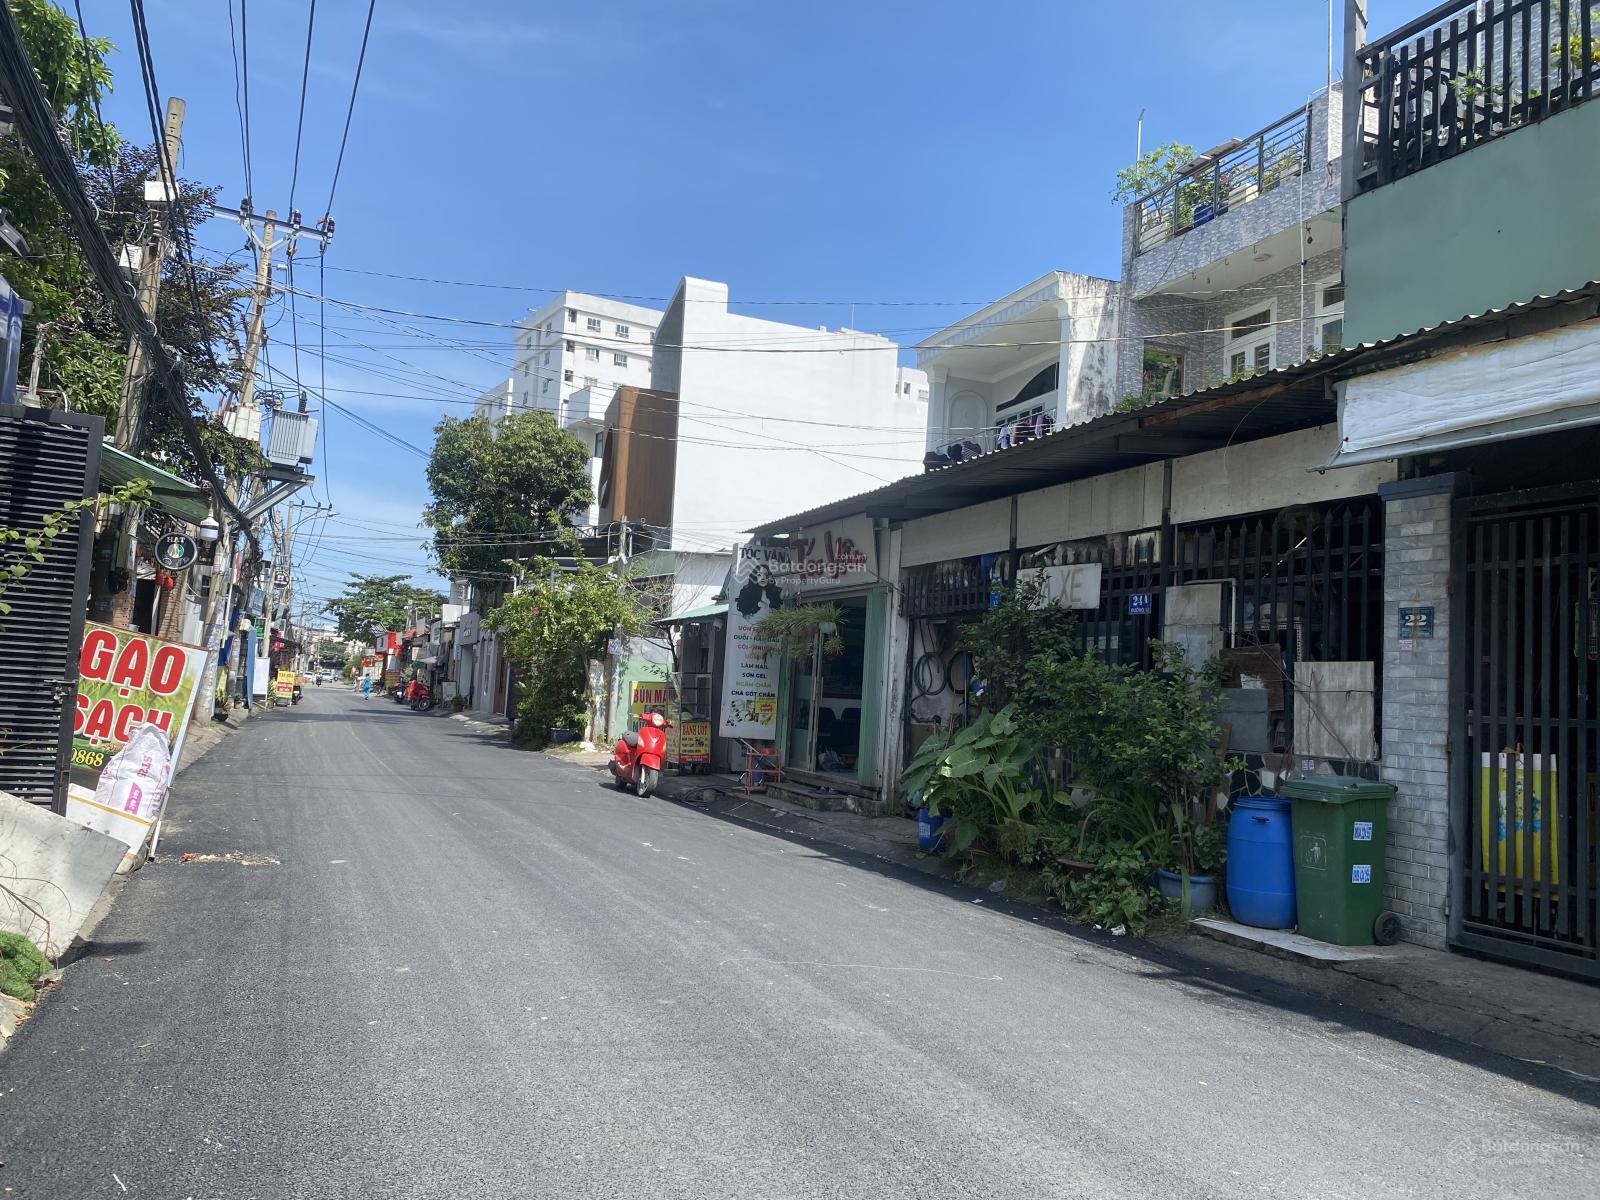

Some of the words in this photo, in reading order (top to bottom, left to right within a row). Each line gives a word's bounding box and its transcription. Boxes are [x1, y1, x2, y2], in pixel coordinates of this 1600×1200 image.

[1058, 567, 1084, 603] XE
[1404, 613, 1428, 626] 22
[80, 629, 187, 698] GẠO
[633, 685, 652, 704] BÚN
